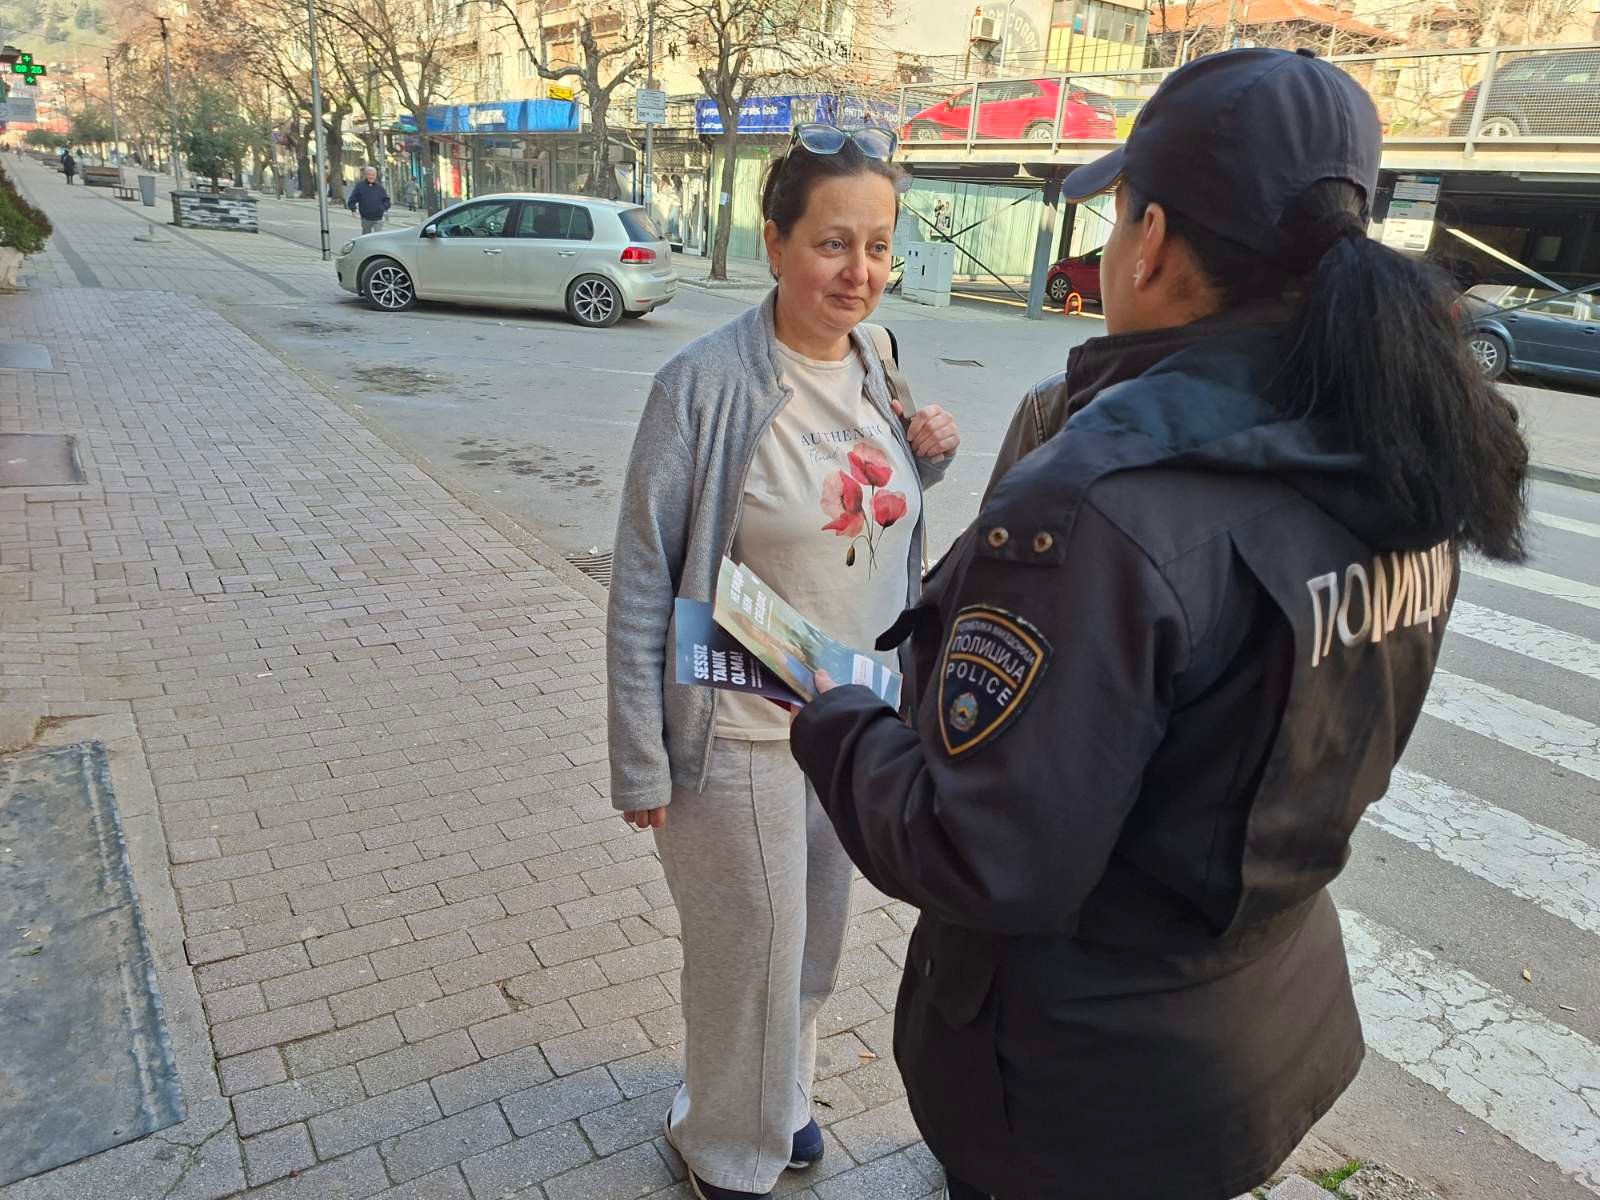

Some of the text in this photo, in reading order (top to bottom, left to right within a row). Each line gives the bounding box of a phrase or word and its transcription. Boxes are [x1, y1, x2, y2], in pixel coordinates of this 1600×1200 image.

[712, 650, 727, 682] TANIK
[730, 651, 747, 685] OLMA!
[951, 634, 1026, 684] ПОЛИЦИЈА
[945, 662, 1013, 707] POLICE
